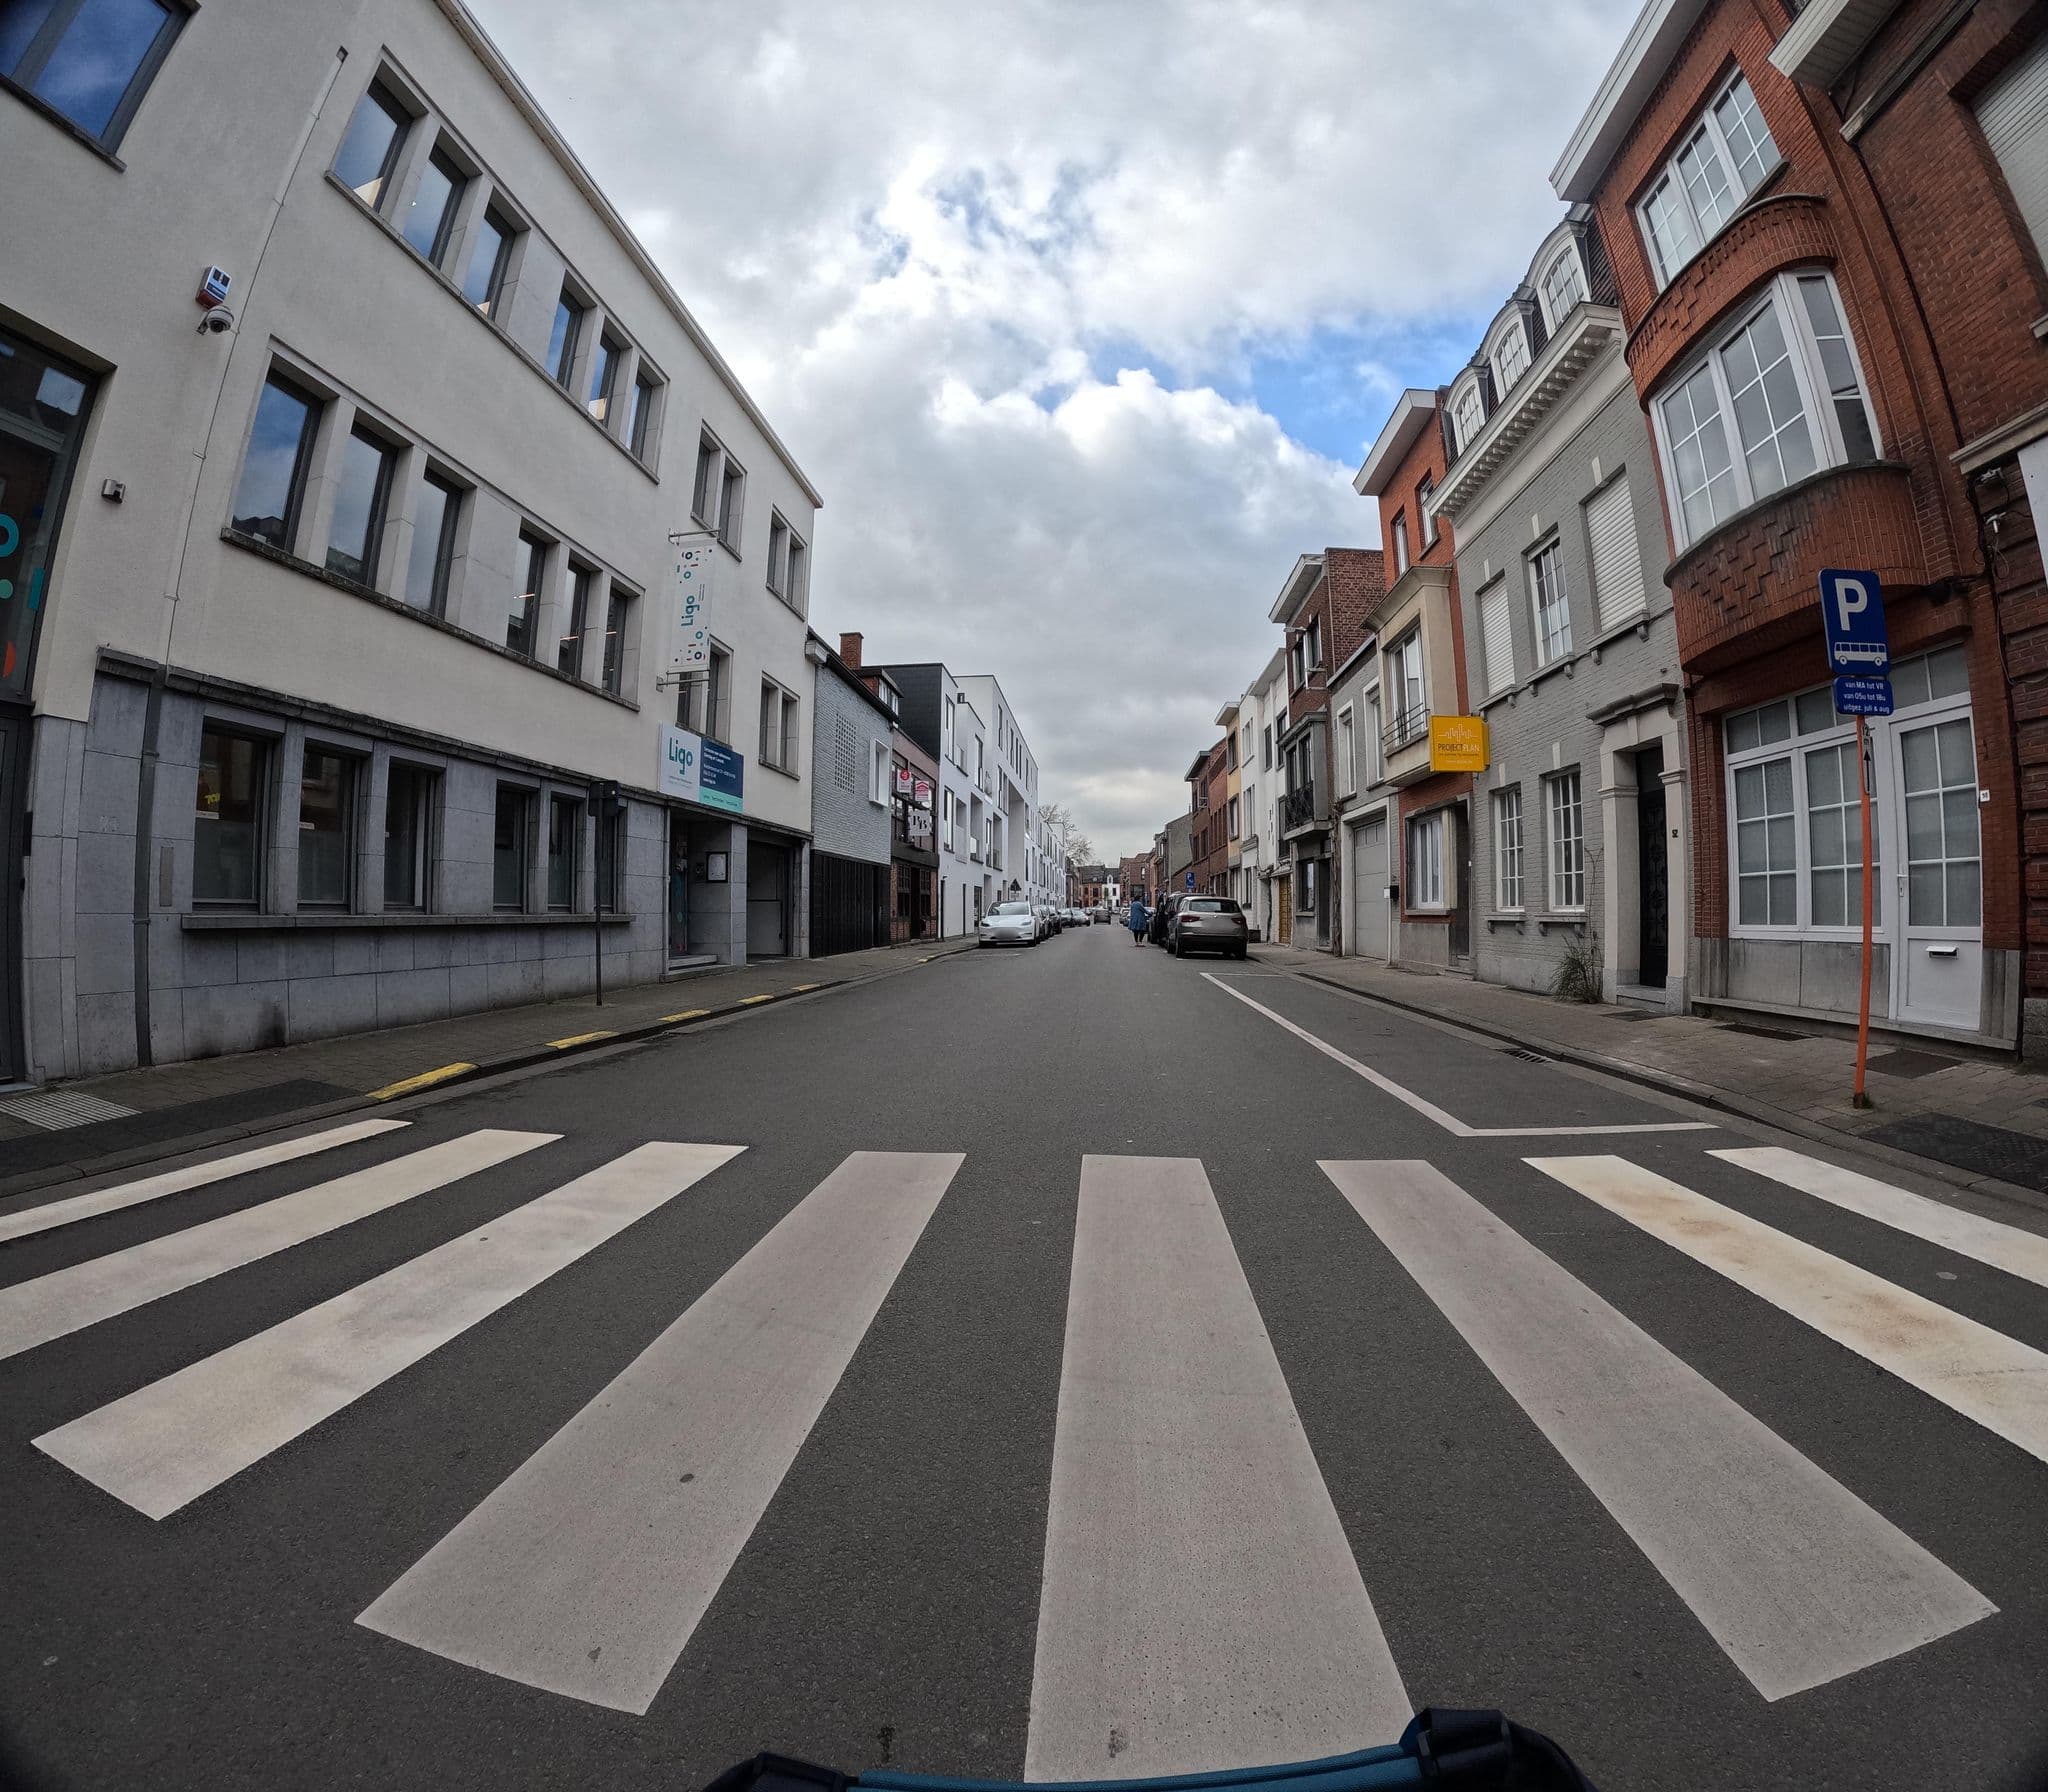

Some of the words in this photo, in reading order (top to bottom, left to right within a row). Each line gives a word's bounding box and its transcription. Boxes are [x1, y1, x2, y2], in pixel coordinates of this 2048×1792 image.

[681, 595, 700, 627] Ligo
[1835, 578, 1868, 631] P
[1856, 681, 1866, 689] MA
[1866, 682, 1875, 690] tot
[669, 737, 693, 775] Ligo
